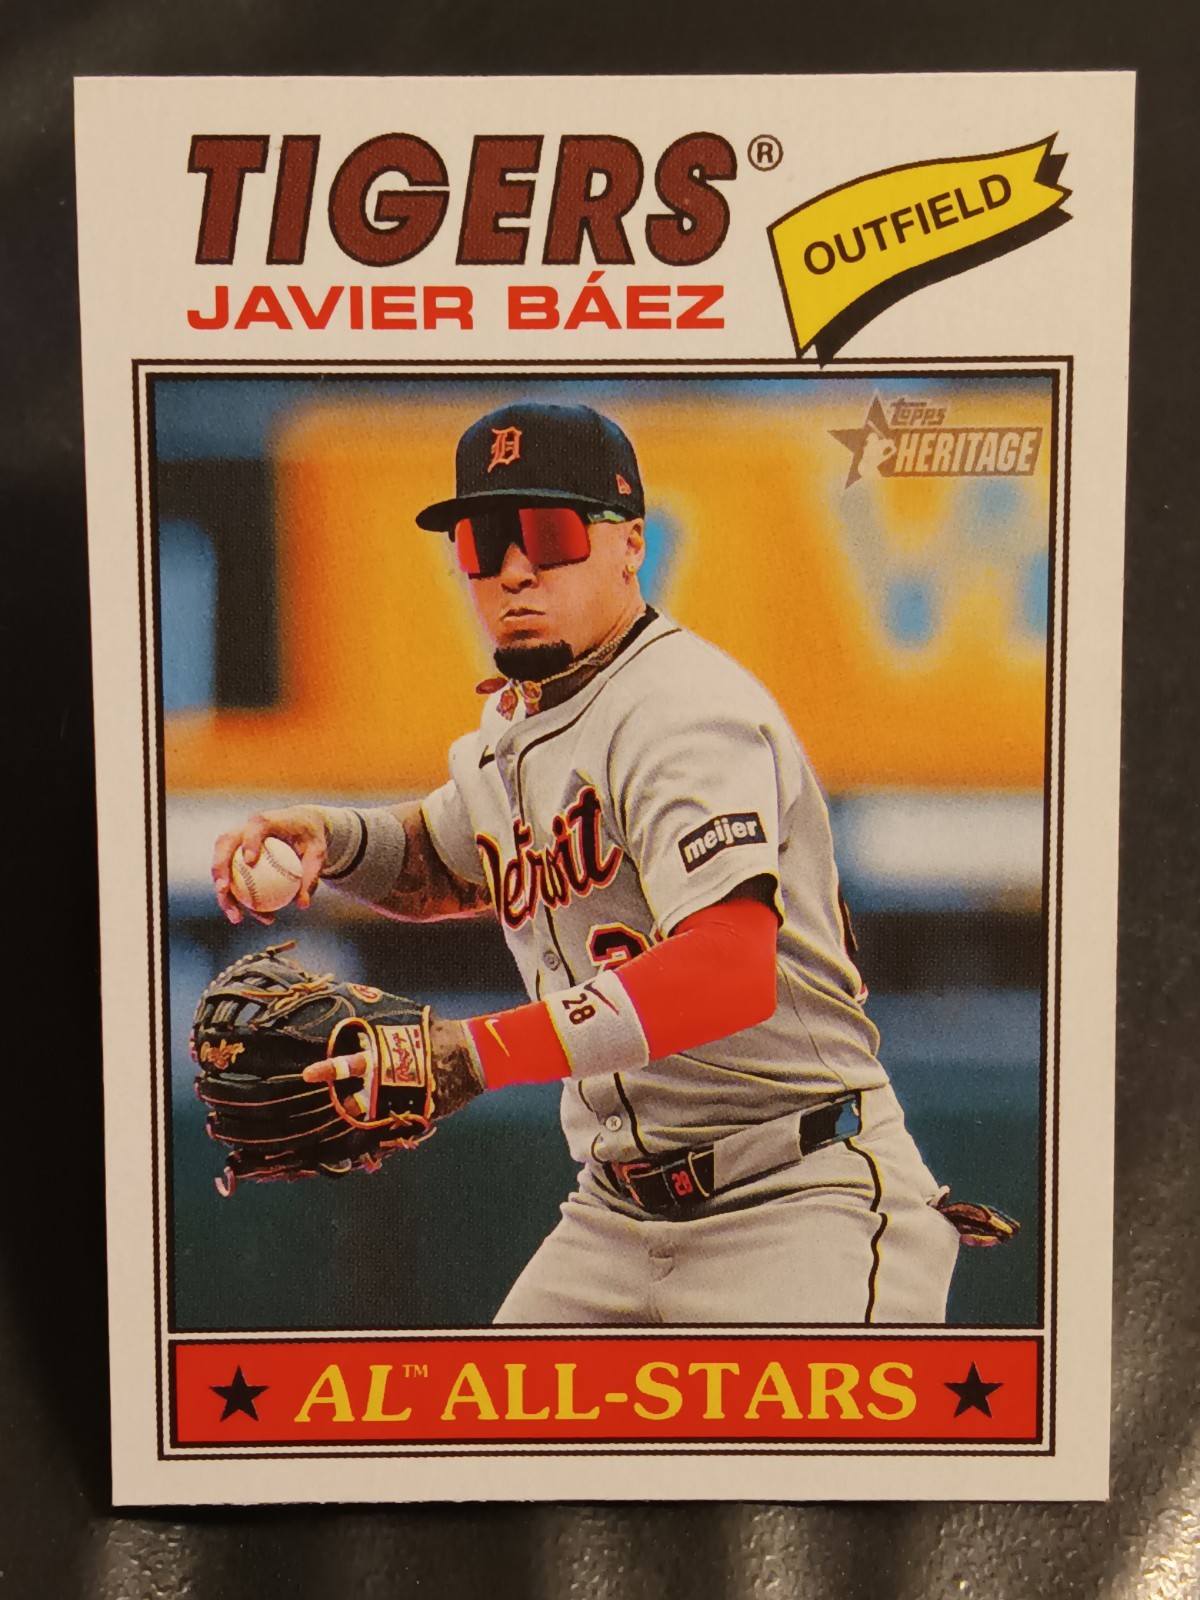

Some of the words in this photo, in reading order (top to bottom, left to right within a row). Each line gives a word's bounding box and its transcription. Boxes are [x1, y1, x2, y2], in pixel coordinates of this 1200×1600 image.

[803, 173, 1012, 275] OUTFIELD
[186, 285, 474, 331] JAVIER
[507, 270, 725, 331] BÁEZ
[487, 426, 522, 473] D
[893, 431, 1038, 473] HERITAGE
[684, 816, 759, 864] meijer
[561, 992, 596, 1026] 28
[440, 1361, 917, 1421] ALL-STARS
